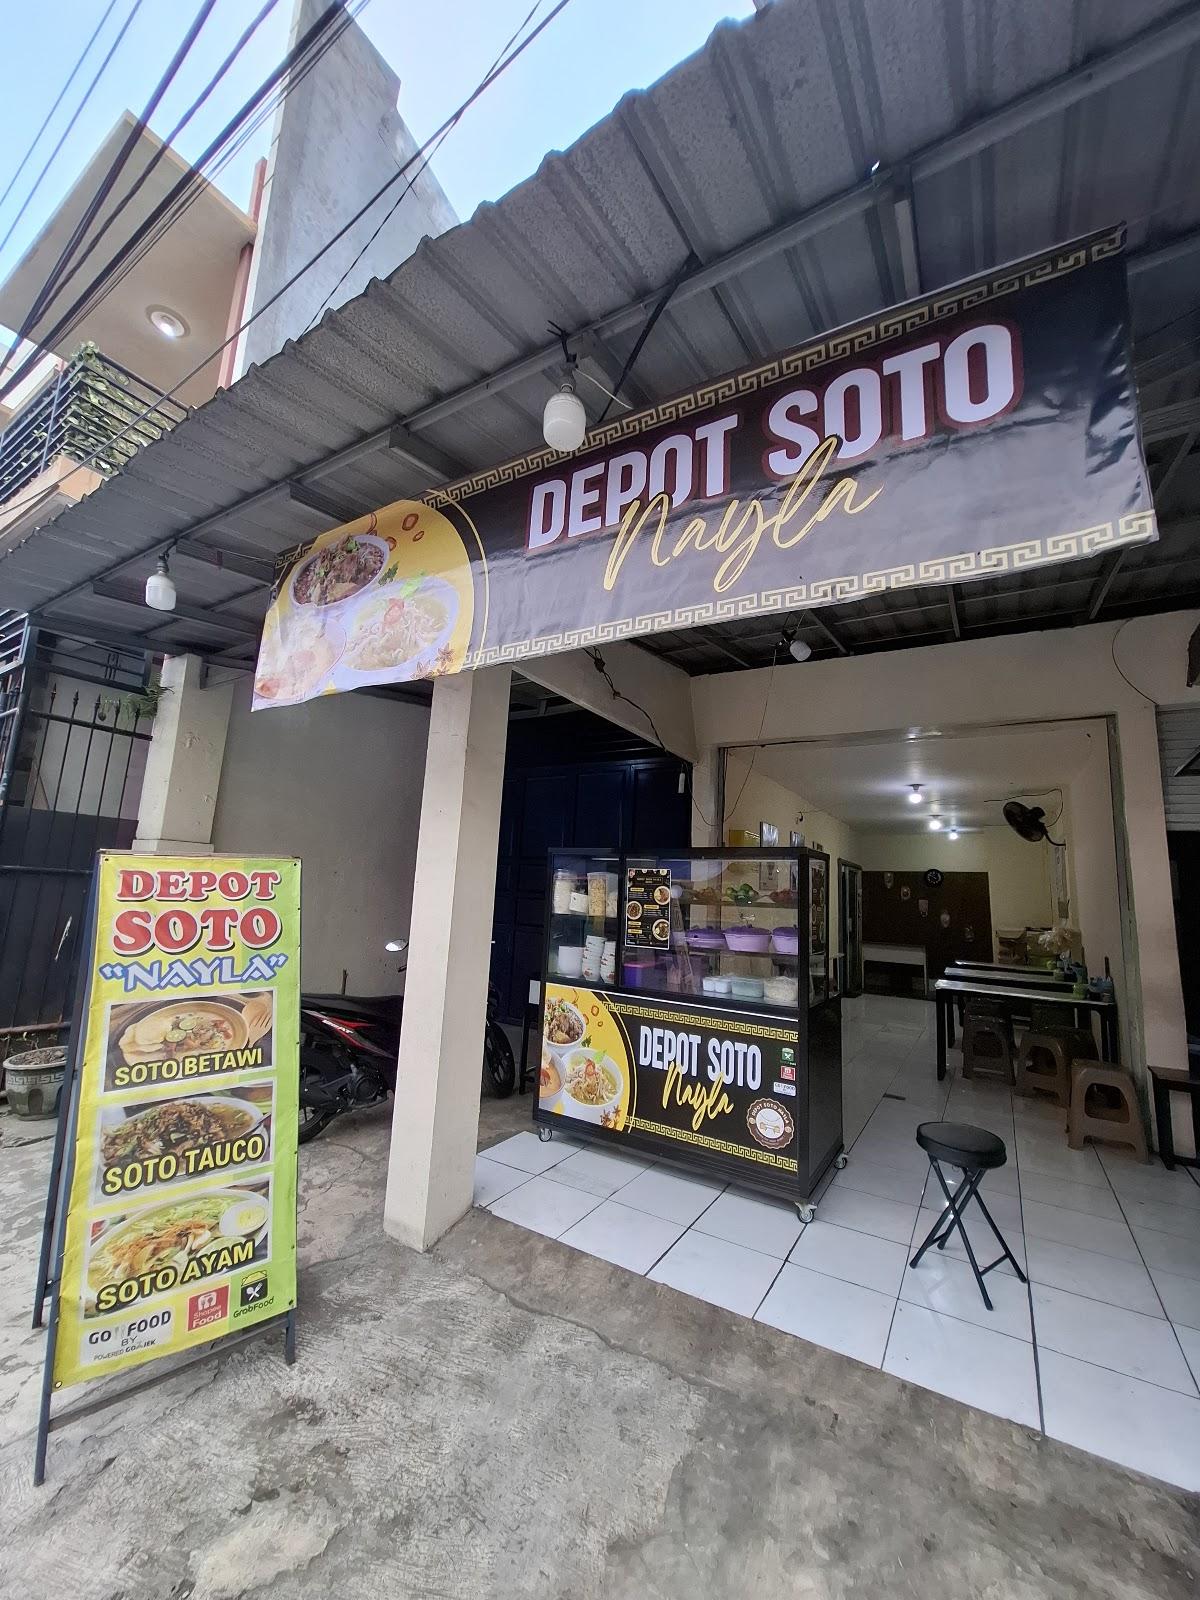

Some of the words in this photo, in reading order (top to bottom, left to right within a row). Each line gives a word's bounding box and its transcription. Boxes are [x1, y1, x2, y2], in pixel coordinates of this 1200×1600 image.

[527, 413, 739, 549] DEPOT
[766, 324, 1015, 476] SOTO
[116, 869, 281, 900] DEPOT
[112, 907, 282, 954] SOTO
[113, 1059, 178, 1087] SOTO
[183, 1047, 263, 1076] BETAWI
[640, 1025, 702, 1077] DEPOT
[707, 1037, 762, 1091] SOTO
[104, 1155, 178, 1195] SOTO
[185, 1135, 264, 1175] TAUCO
[97, 1267, 177, 1312] SOTO
[181, 1240, 255, 1285] AYAM
[192, 1310, 222, 1328] Food
[233, 1296, 275, 1319] GrabFood
[88, 1330, 112, 1345] GO
[127, 1310, 172, 1337] FOOD
[121, 1335, 138, 1347] BY
[93, 1348, 125, 1361] POWERED
